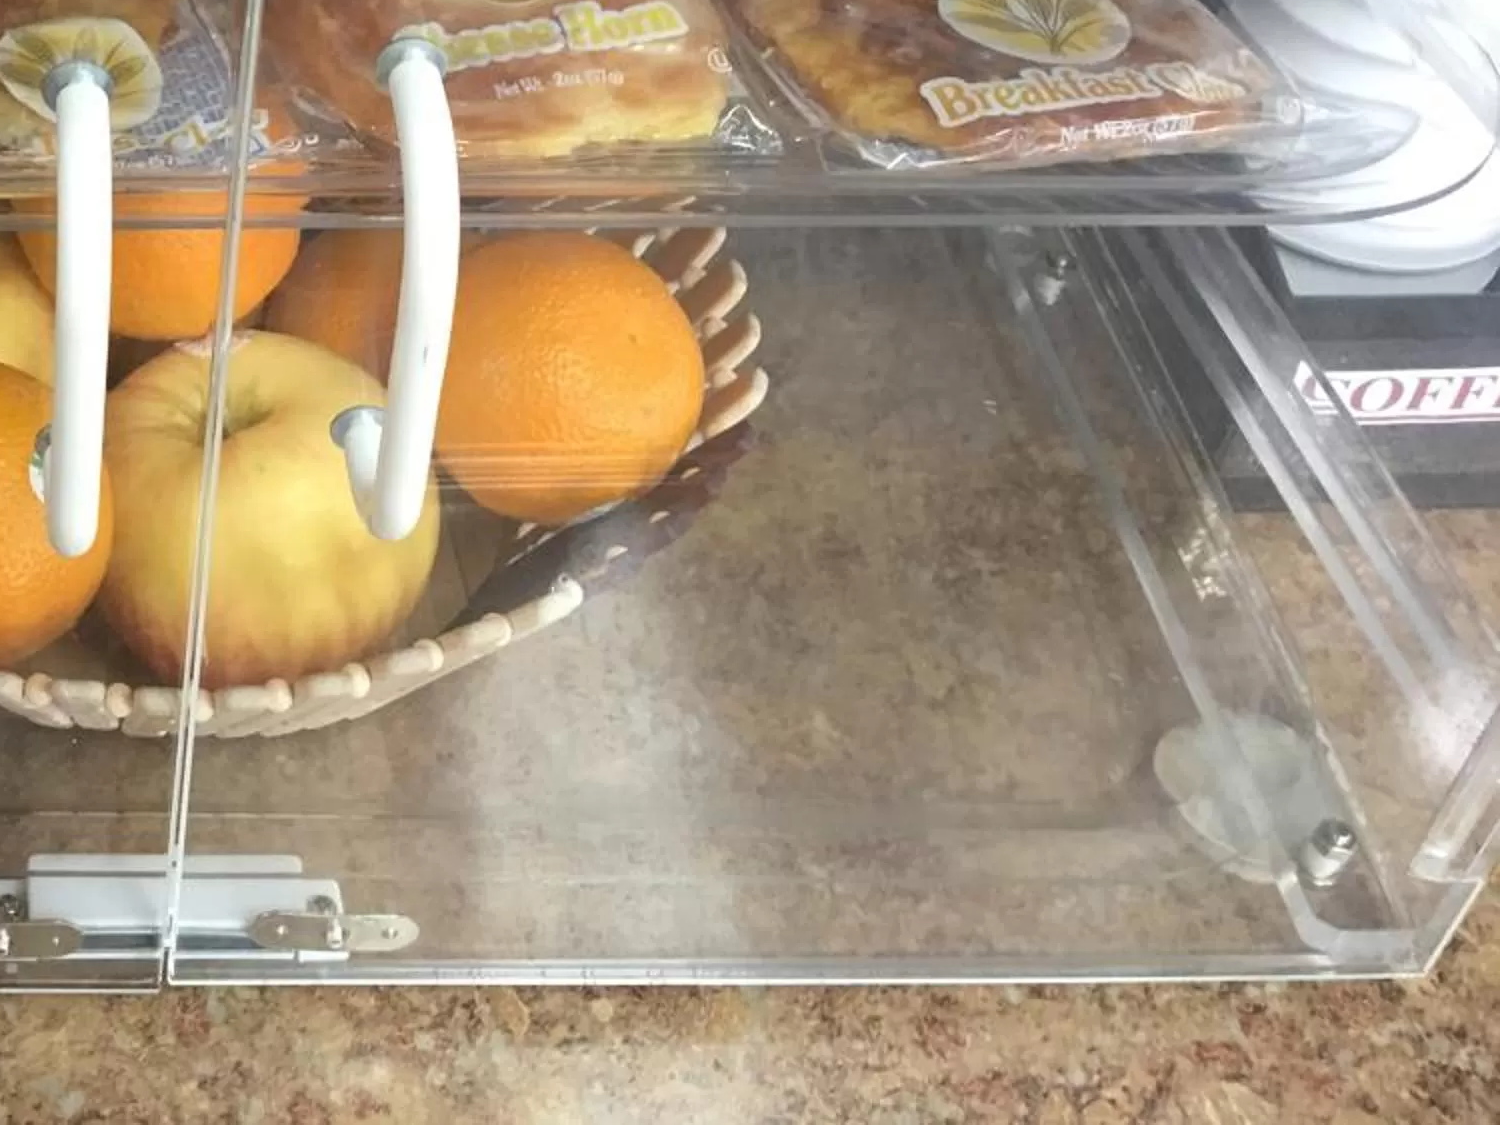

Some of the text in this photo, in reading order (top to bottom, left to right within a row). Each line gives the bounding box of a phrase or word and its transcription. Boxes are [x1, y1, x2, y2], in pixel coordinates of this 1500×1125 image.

[553, 0, 689, 52] Horn
[920, 67, 1163, 130] Breakfast
[1302, 375, 1500, 415] COFF
